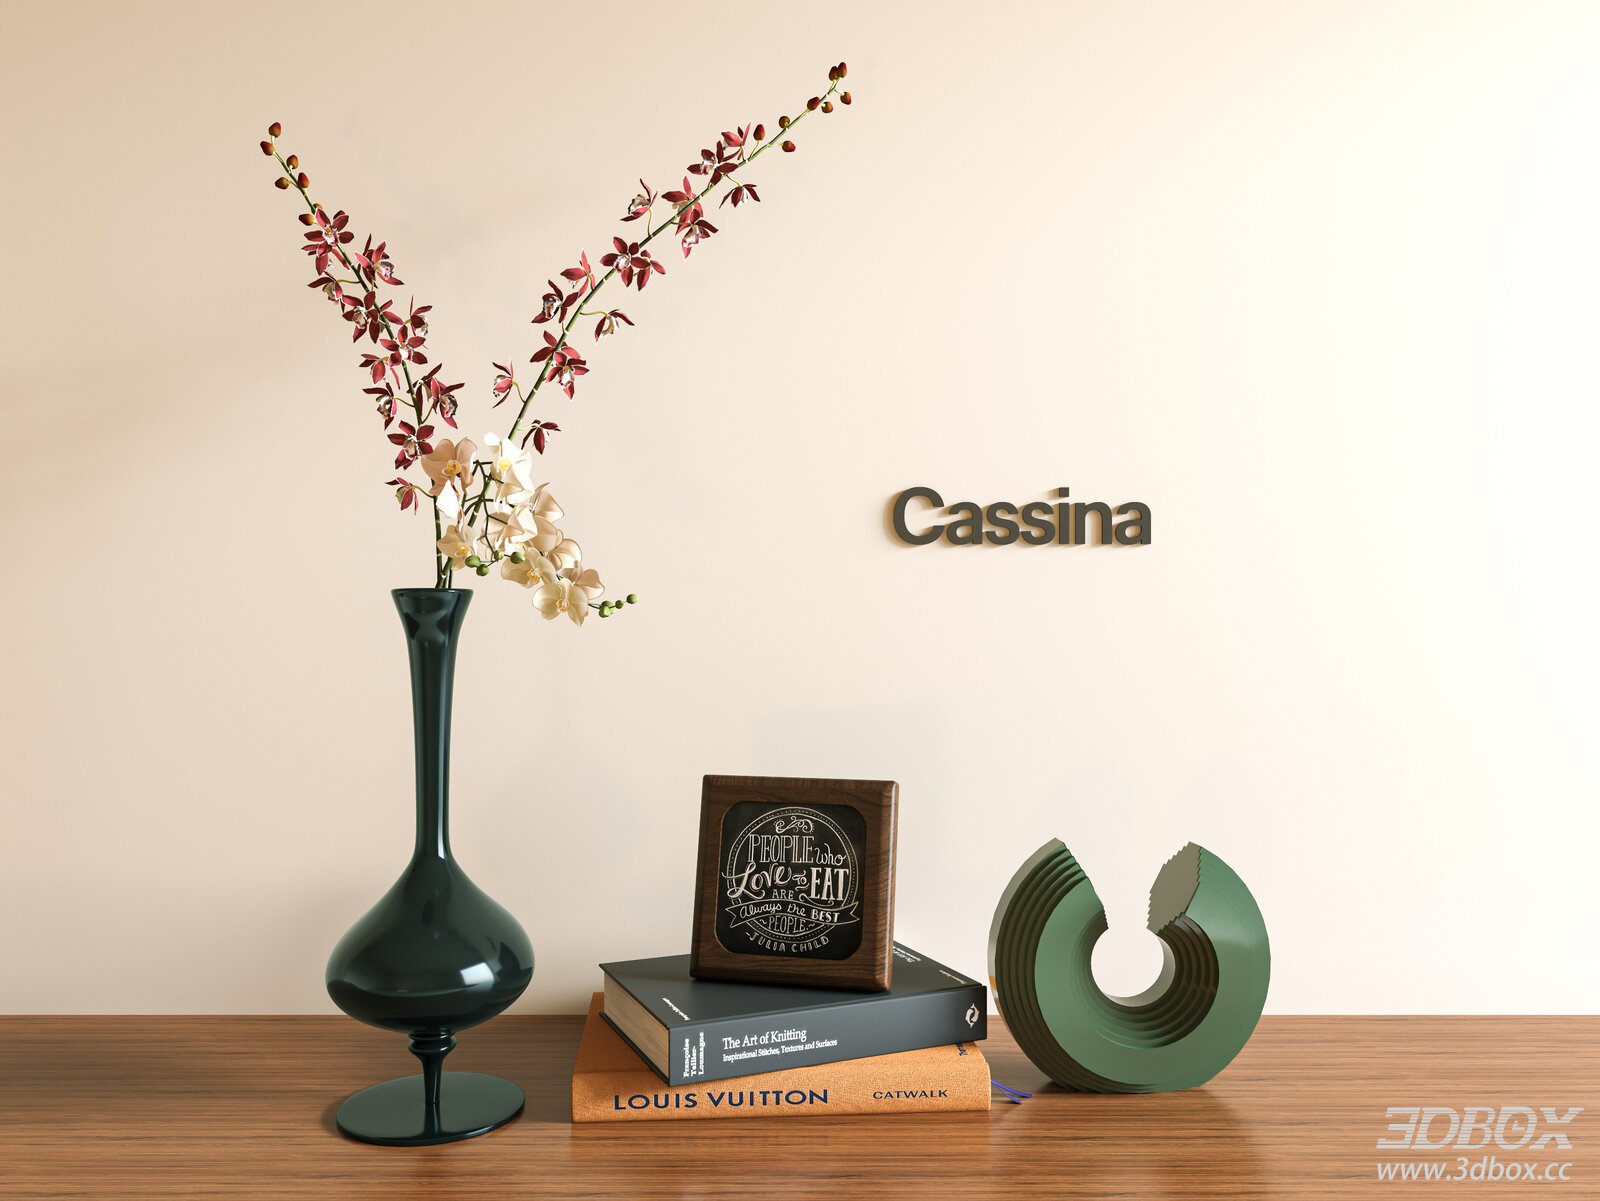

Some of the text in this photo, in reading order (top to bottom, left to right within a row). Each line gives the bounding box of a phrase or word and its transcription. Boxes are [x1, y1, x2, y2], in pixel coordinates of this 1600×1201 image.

[893, 486, 1152, 546] Cassina
[748, 834, 847, 866] PEOPLE who
[721, 862, 793, 899] Love
[809, 867, 850, 901] EAT
[772, 888, 795, 900] ARE
[787, 903, 807, 917] the
[811, 908, 841, 923] BEST
[791, 935, 830, 953] CHILD
[723, 1028, 807, 1050] The Art of Knitting
[722, 1038, 838, 1063] Inspirational Stitches, Textures and Surfaces
[614, 1089, 828, 1110] LOUIS VUITTON
[872, 1089, 948, 1100] CATWALK
